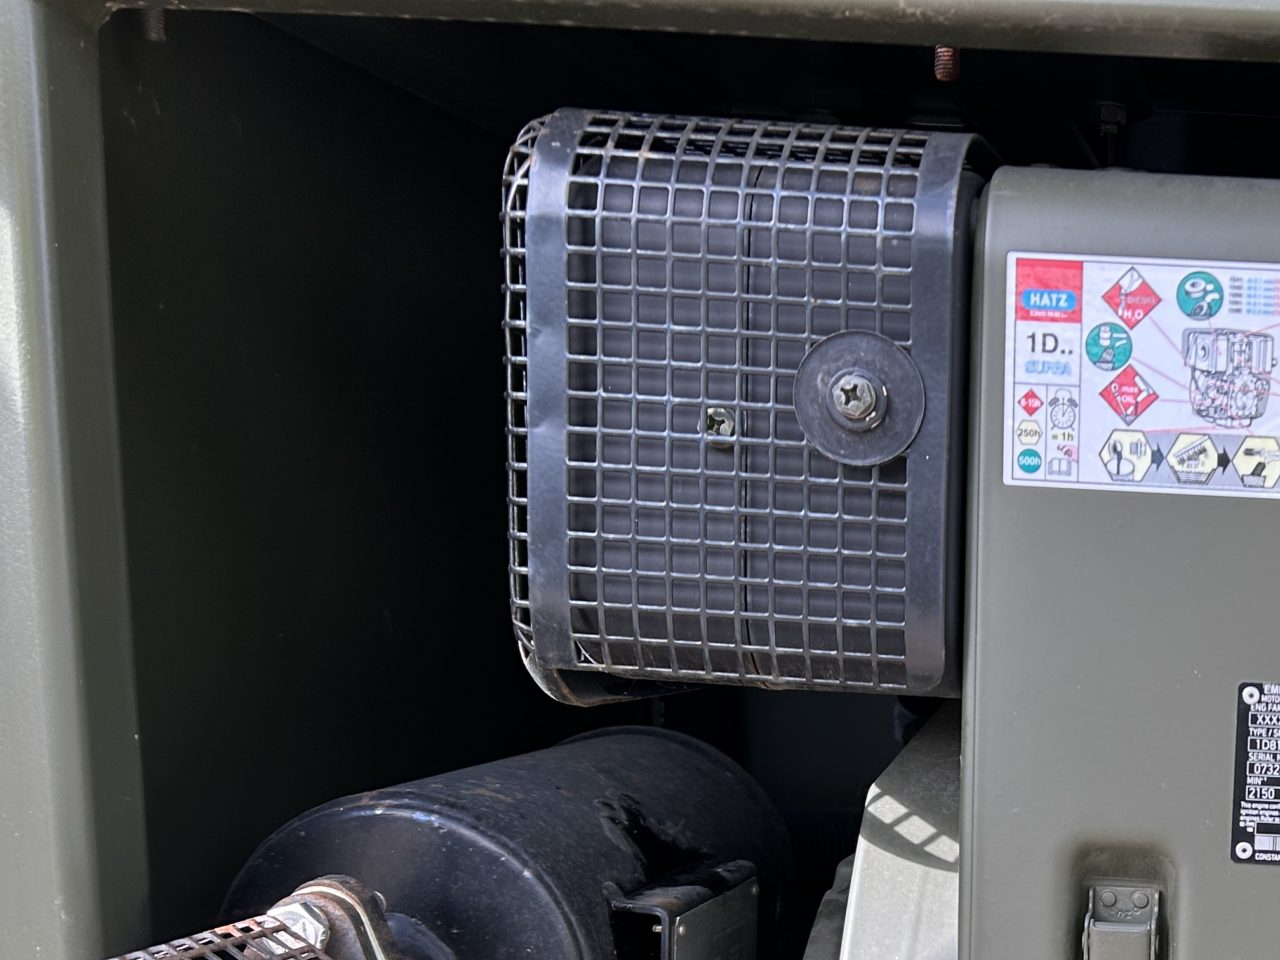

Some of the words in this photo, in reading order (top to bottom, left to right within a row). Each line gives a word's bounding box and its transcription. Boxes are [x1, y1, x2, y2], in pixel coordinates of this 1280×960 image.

[1029, 292, 1068, 308] HATZ
[1018, 428, 1041, 438] 250h
[1019, 456, 1041, 466] 500h
[1249, 728, 1267, 737] TYPE
[1248, 752, 1275, 762] SERIAL
[1248, 787, 1275, 800] 2150
